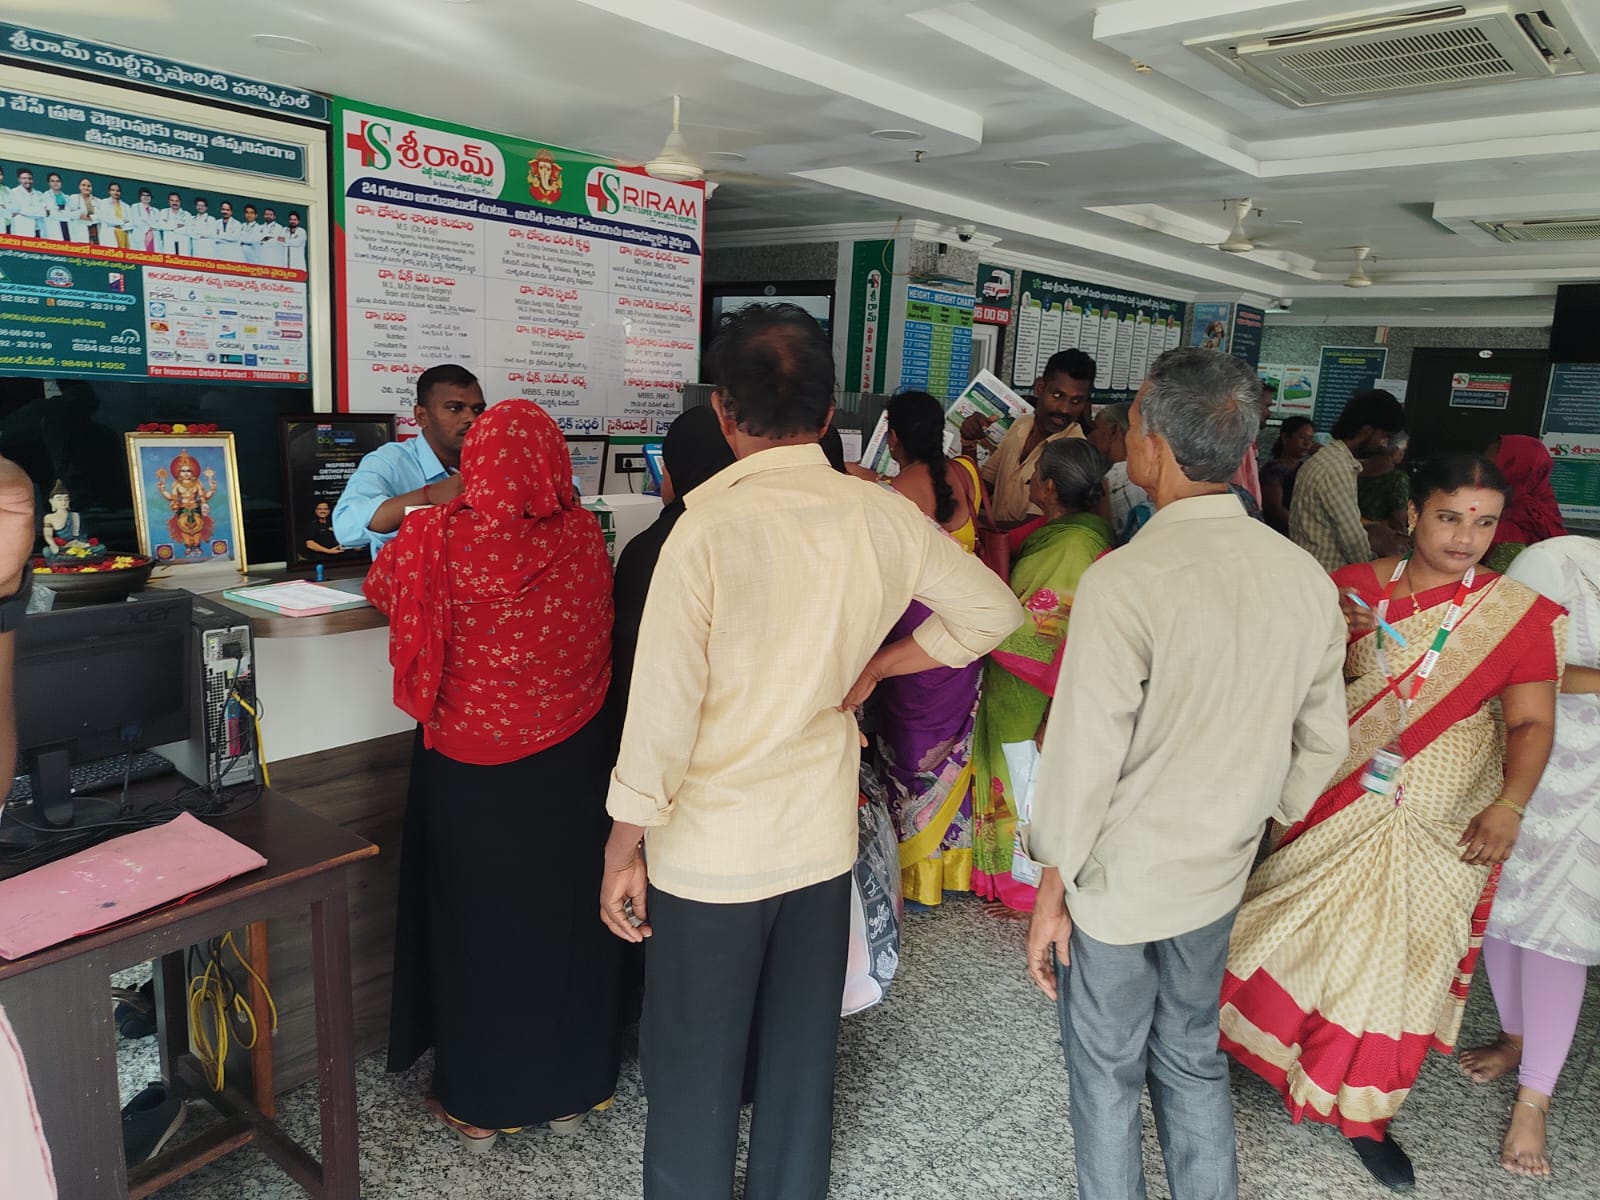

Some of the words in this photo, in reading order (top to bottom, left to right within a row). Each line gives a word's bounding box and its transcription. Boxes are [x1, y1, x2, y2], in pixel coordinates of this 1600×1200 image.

[8, 30, 90, 61] శ్రీరామ్
[232, 81, 311, 109] హాస్పిటల్
[396, 130, 494, 177] శ్రీరామ్
[361, 182, 377, 195] 24
[908, 288, 930, 301] HEIGHT
[934, 293, 956, 305] WEIGHT
[956, 296, 974, 307] CHART
[150, 367, 162, 375] For
[163, 367, 198, 377] Insurance
[199, 369, 222, 378] Details
[223, 370, 247, 378] Contact
